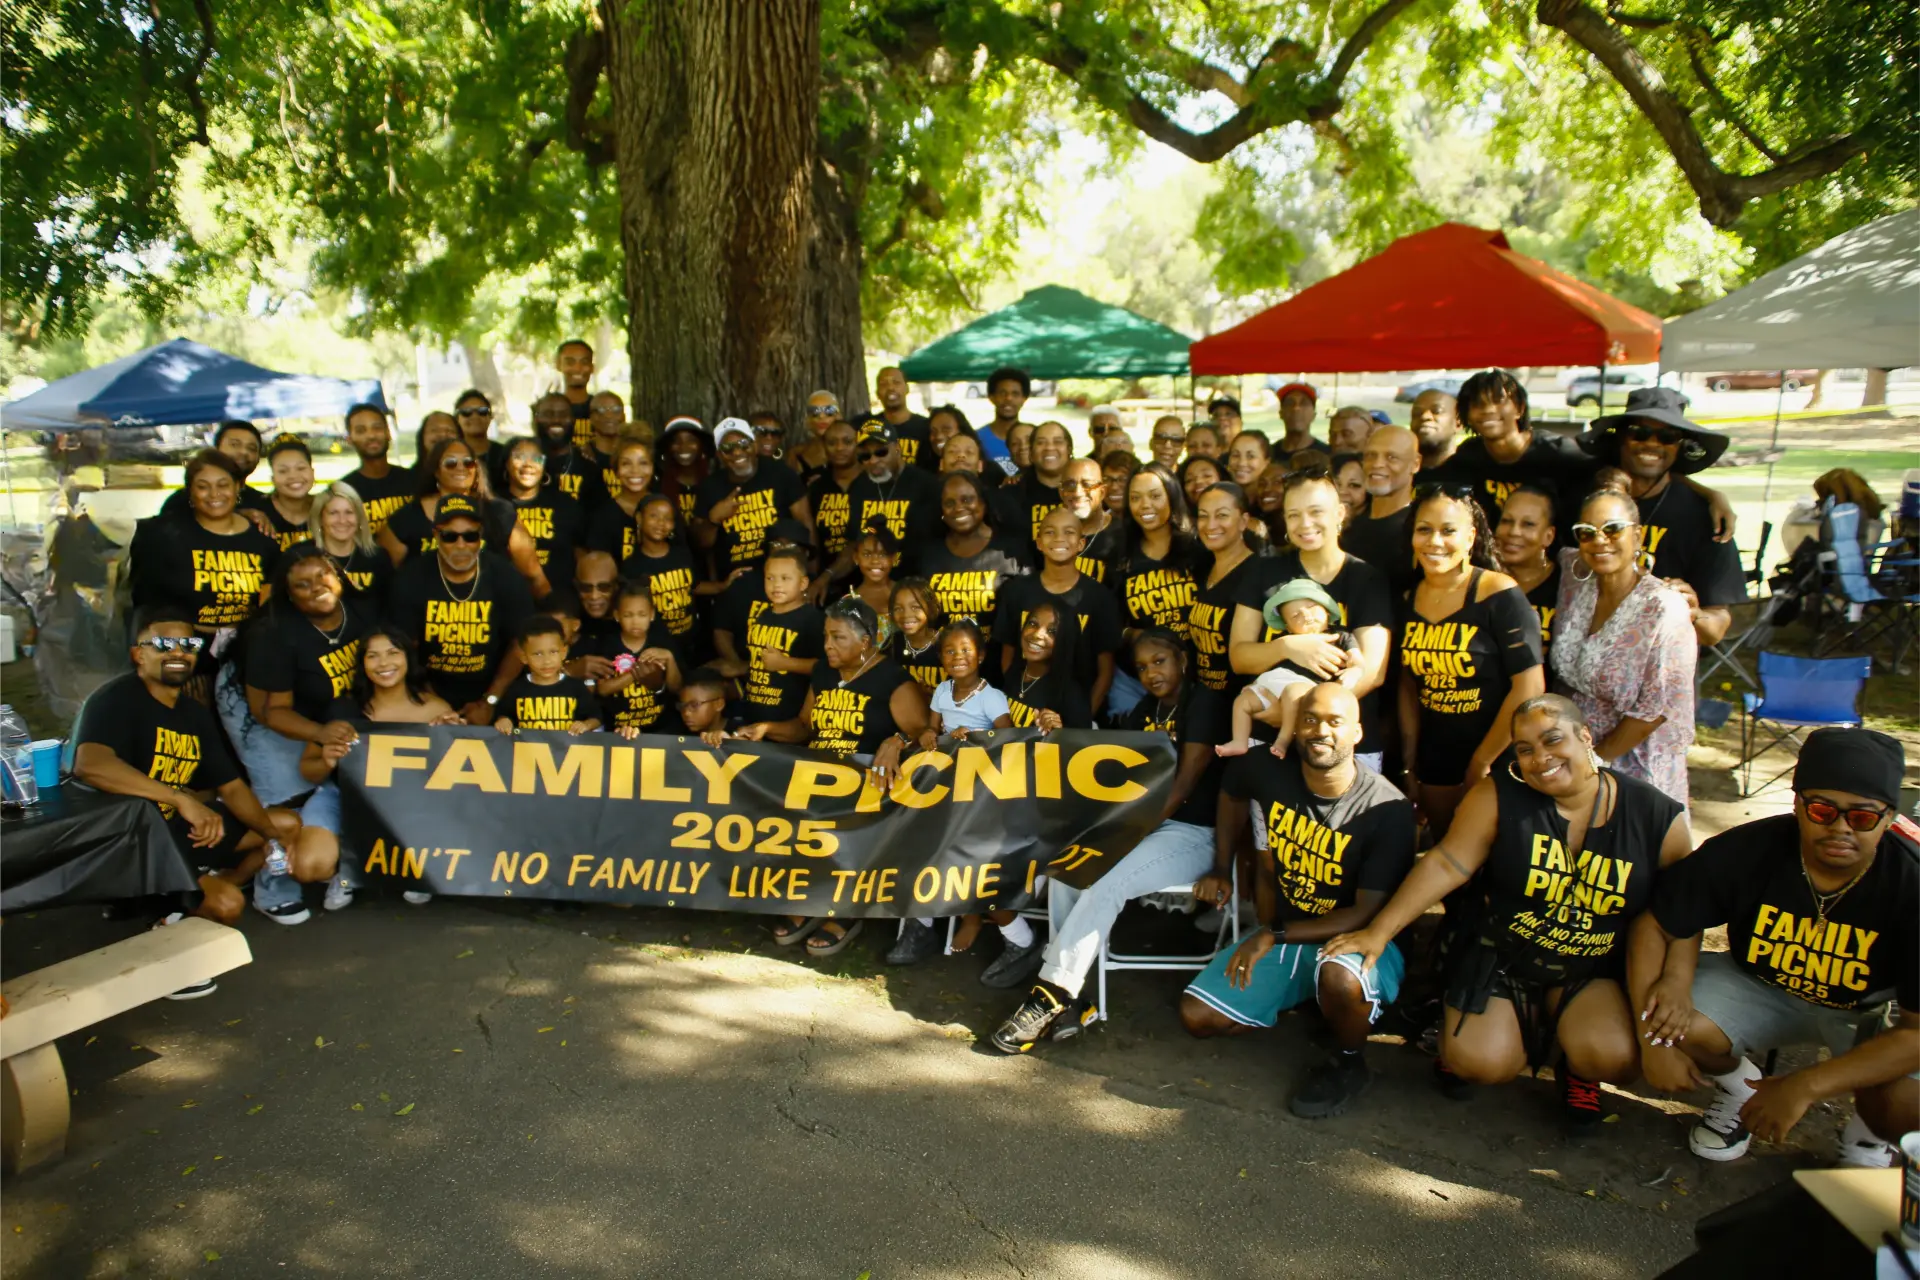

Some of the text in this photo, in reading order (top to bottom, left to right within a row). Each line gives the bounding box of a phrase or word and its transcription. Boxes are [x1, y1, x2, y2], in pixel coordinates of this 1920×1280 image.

[192, 549, 263, 573] FAMILY
[649, 568, 693, 595] AMILY
[929, 570, 997, 591] FAMILY
[426, 600, 493, 624] FAMILY
[1127, 582, 1199, 620] PICNIC
[424, 622, 491, 644] PICNIC
[1401, 622, 1479, 652] FAMILY
[442, 643, 472, 657] 2025
[1402, 649, 1476, 678] PICNIC
[1424, 675, 1457, 689] 2025
[1443, 688, 1481, 703] FAMILY
[516, 696, 577, 720] FAMILY
[811, 708, 864, 735] PICNIC
[365, 734, 1149, 812] FAMILY PICNIC
[670, 812, 839, 858] 2025
[1269, 801, 1352, 863] FAMILY
[364, 838, 472, 881] AIN'T
[491, 851, 549, 885] NO
[567, 854, 711, 895] FAMILY
[728, 866, 810, 900] LIKE
[830, 867, 898, 903] THE
[913, 863, 1002, 903] ONE
[1024, 859, 1037, 894] I
[1268, 829, 1343, 886] PICNIC
[1530, 833, 1633, 894] FAMILY
[1524, 868, 1626, 916] PICNIC
[1508, 922, 1535, 940] LIKE
[1535, 936, 1559, 950] THE
[1557, 945, 1583, 956] ONE
[1590, 944, 1615, 956] GOT
[1548, 927, 1570, 941] NO
[1569, 931, 1615, 947] FAMILY
[1753, 903, 1880, 961] FAMILY
[1746, 936, 1871, 992] PICNIC
[1775, 973, 1829, 999] 2025
